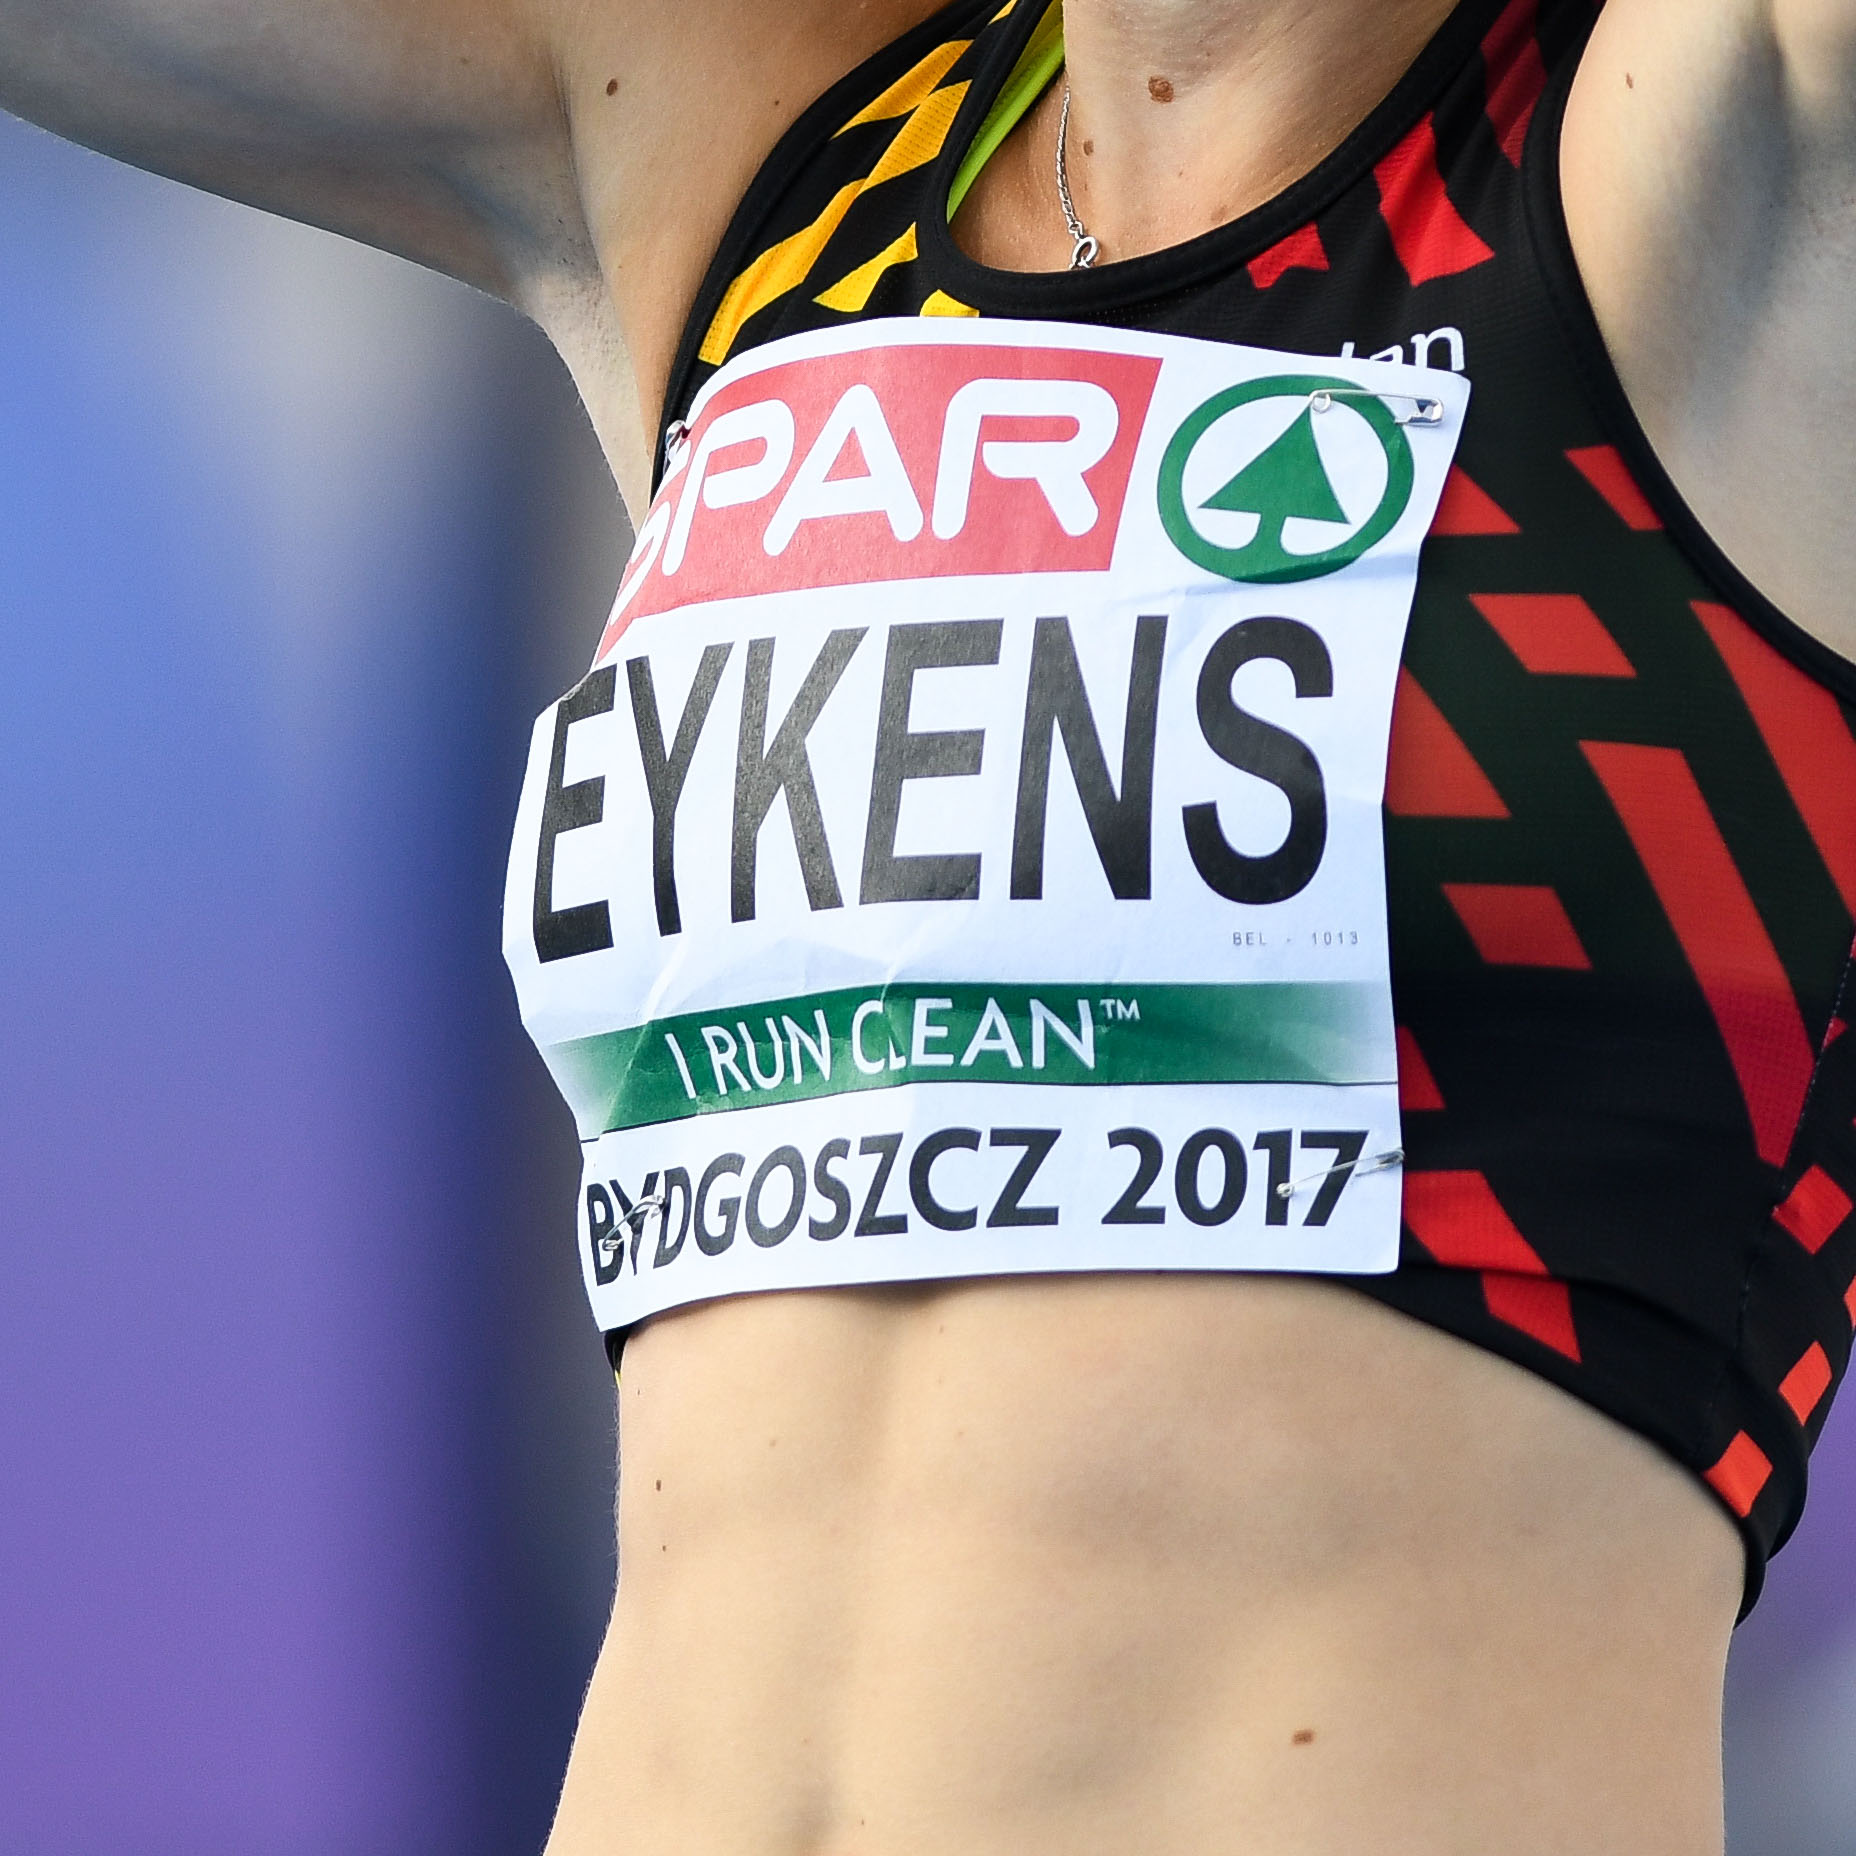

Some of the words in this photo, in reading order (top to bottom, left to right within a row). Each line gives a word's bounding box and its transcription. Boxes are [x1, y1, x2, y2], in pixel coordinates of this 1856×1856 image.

[533, 614, 1334, 964] EYKENS
[1232, 931, 1266, 946] BEL
[1311, 931, 1358, 945] 1013
[665, 1032, 697, 1099] I
[701, 1009, 833, 1096] RUN
[586, 1126, 1063, 1286] BYDGOSZCZ
[1101, 1126, 1370, 1227] 2017
